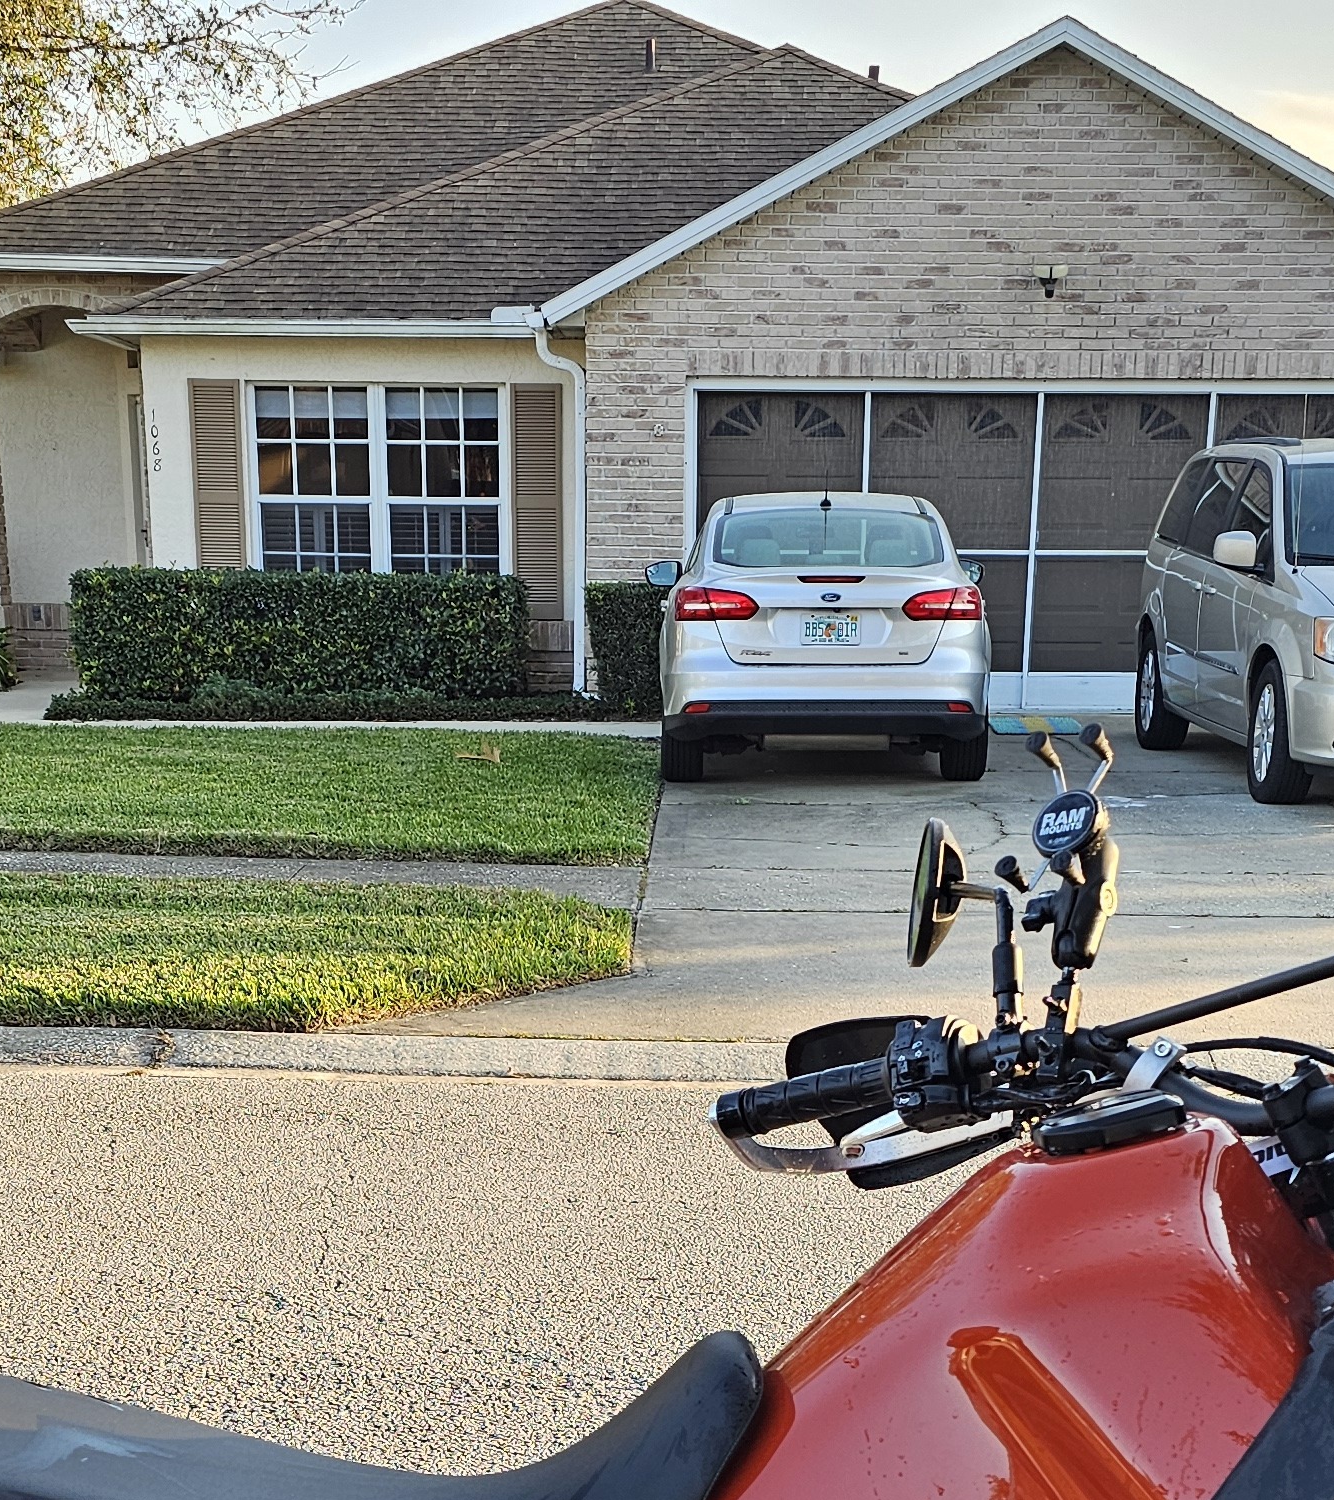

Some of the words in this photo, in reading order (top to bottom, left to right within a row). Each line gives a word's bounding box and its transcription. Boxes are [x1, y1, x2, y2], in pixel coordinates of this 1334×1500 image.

[150, 408, 162, 472] 1068
[1041, 806, 1086, 828] RAM
[1039, 822, 1083, 836] MOUNTS
